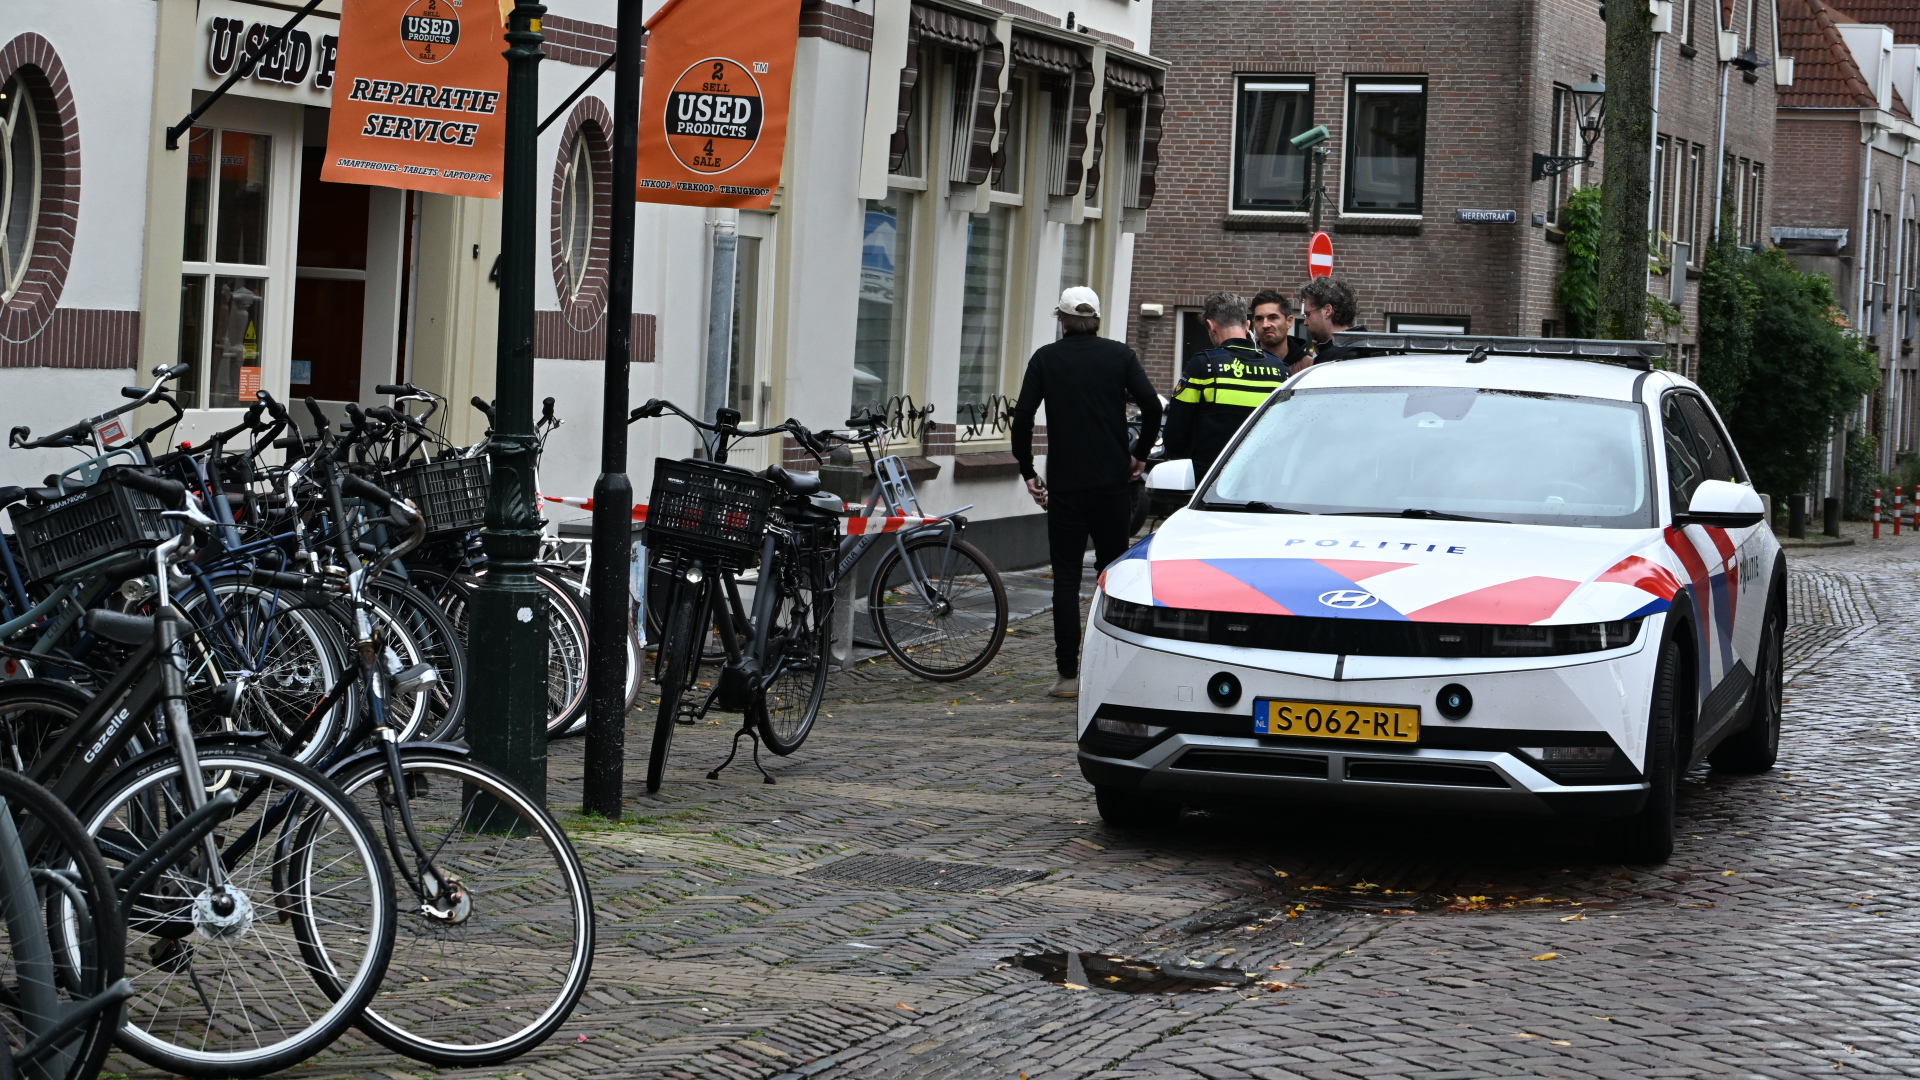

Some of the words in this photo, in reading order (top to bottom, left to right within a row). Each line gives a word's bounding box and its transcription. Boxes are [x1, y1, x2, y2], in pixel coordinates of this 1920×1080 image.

[428, 0, 436, 10] 2
[408, 17, 453, 36] USED
[408, 33, 451, 43] PRODUCTS
[212, 16, 312, 85] USED
[425, 44, 431, 53] 4
[712, 62, 724, 80] 2
[753, 62, 769, 73] TM
[348, 77, 500, 114] REPARATIE
[702, 83, 730, 93] SELL
[678, 94, 751, 124] USED
[361, 113, 479, 147] SERVICE
[677, 122, 747, 137] PRODUCTS
[703, 139, 714, 156] 4
[693, 156, 721, 167] SALE
[337, 158, 398, 172] SMARTPHONES
[402, 165, 438, 177] TABLETS
[443, 170, 492, 183] LAPTOP/PC
[640, 179, 671, 189] INKOOP
[677, 181, 714, 193] VERKOOP
[720, 185, 770, 196] TERUGKOOP
[1462, 212, 1509, 221] HERENSTRAAT
[1223, 359, 1279, 378] POLITIE
[1284, 538, 1467, 554] POLITIE
[1256, 720, 1266, 728] NL
[1277, 706, 1408, 737] S-062-RL
[84, 708, 130, 763] Gazelle
